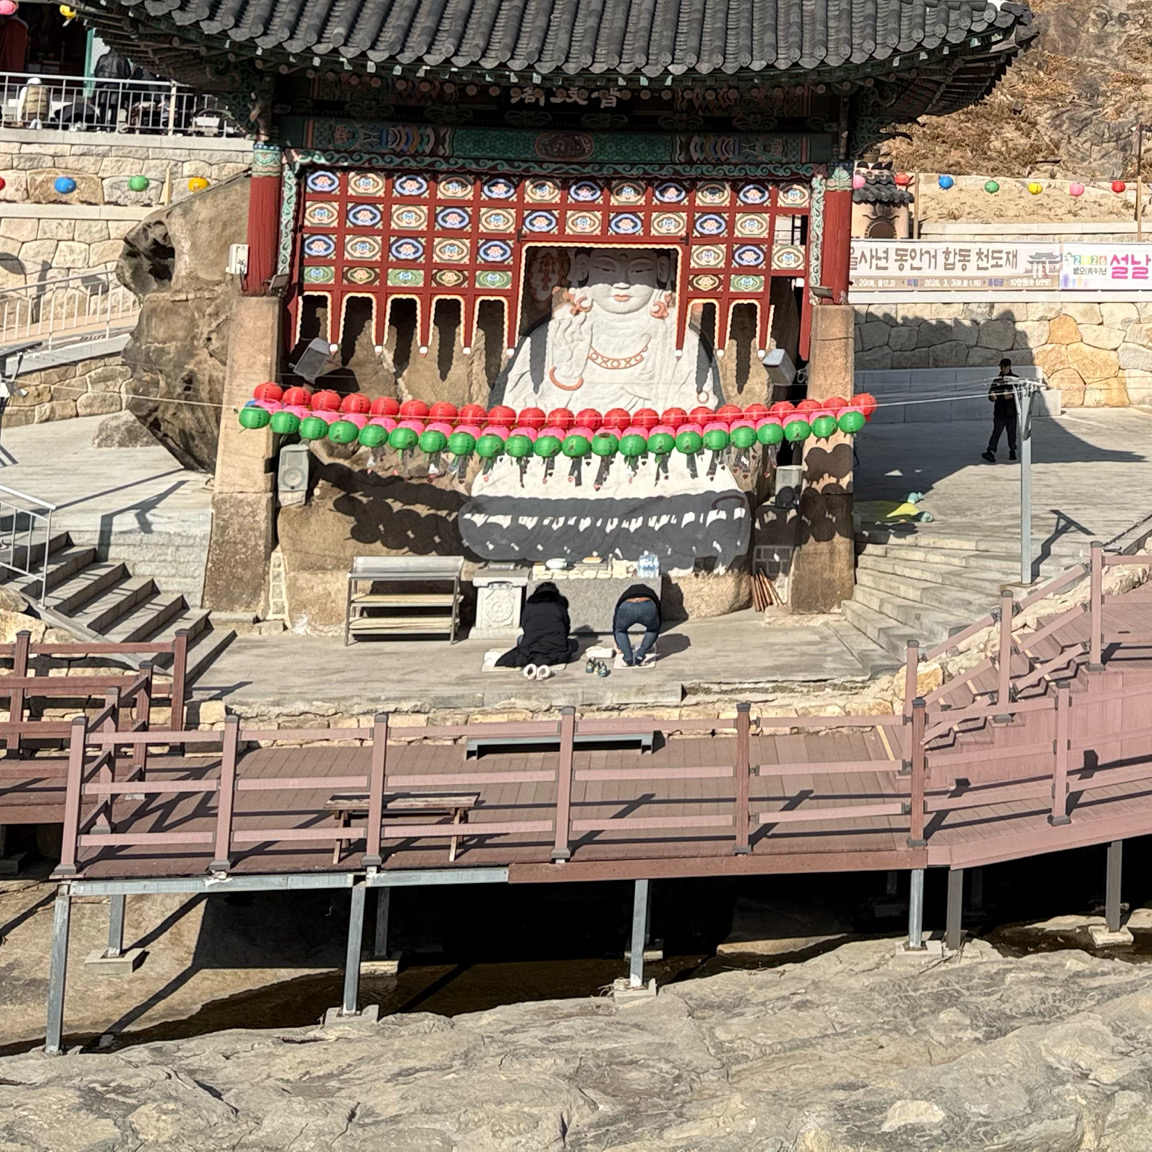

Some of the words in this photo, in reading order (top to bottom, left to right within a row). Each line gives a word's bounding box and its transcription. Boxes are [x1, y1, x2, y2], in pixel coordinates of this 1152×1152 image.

[894, 247, 938, 272] 동안거
[942, 247, 972, 272] 합동
[976, 248, 1018, 271] 천도재
[1073, 255, 1107, 265] 2026
[1110, 254, 1152, 280] 설날
